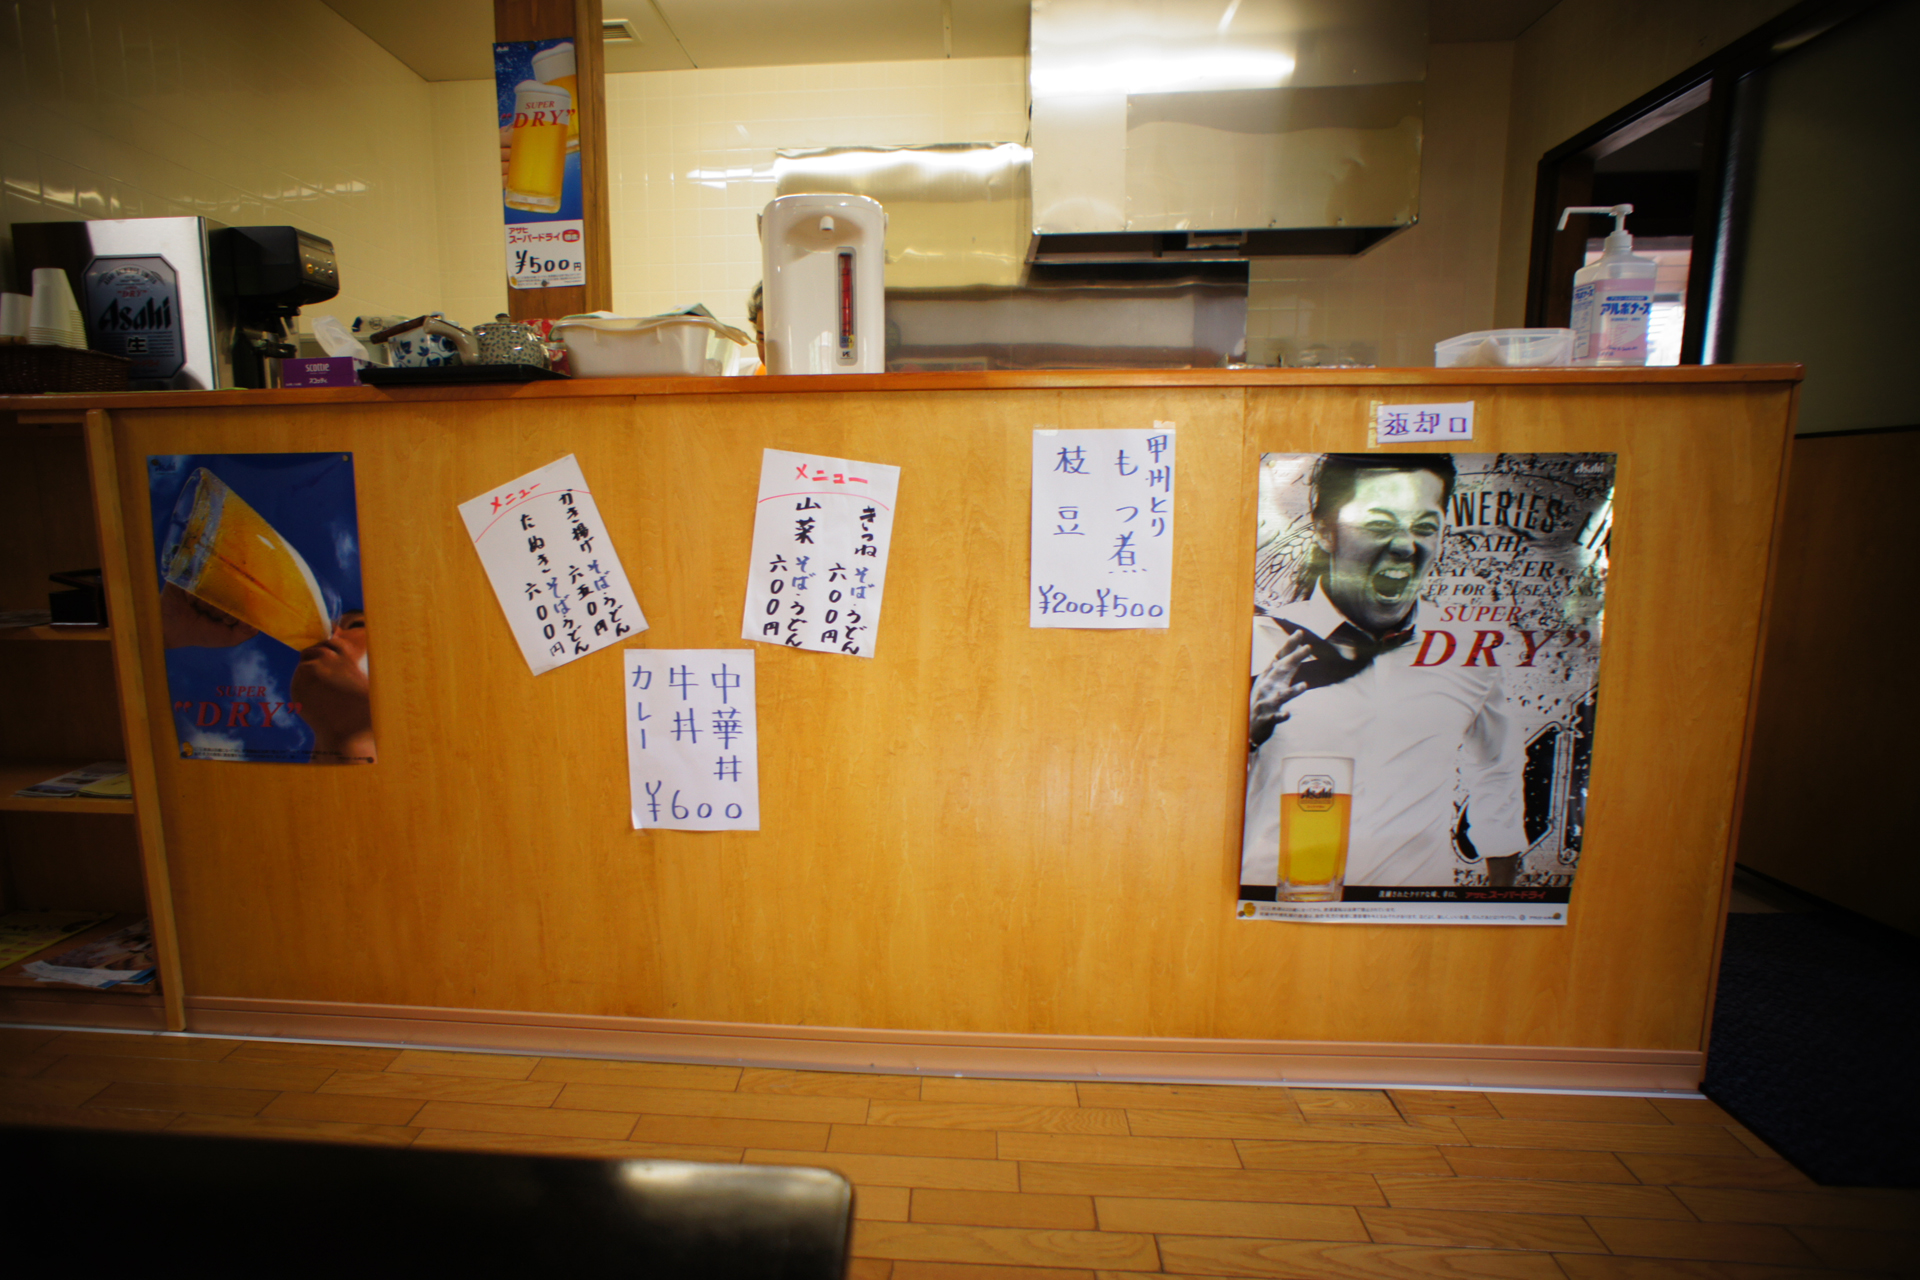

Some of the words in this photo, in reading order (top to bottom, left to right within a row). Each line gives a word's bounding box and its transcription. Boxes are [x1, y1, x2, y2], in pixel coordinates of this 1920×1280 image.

[525, 100, 555, 110] SUPER
[508, 227, 529, 235] アサヒ
[508, 232, 561, 245] スーパードライ
[98, 296, 172, 331] Asahi
[127, 336, 149, 355] 生
[1382, 410, 1467, 436] 返却口
[795, 463, 869, 484] メニュー
[1145, 434, 1171, 537] 甲州とり
[490, 483, 541, 515] メニュー
[1053, 445, 1091, 536] 枝豆
[1107, 449, 1147, 574] もつ煮
[1038, 584, 1094, 615] ¥200
[1096, 588, 1164, 617] ¥500
[1440, 606, 1523, 622] SUPER
[216, 686, 266, 697] SUPER
[631, 665, 652, 749] カレー
[645, 780, 743, 822] ¥600
